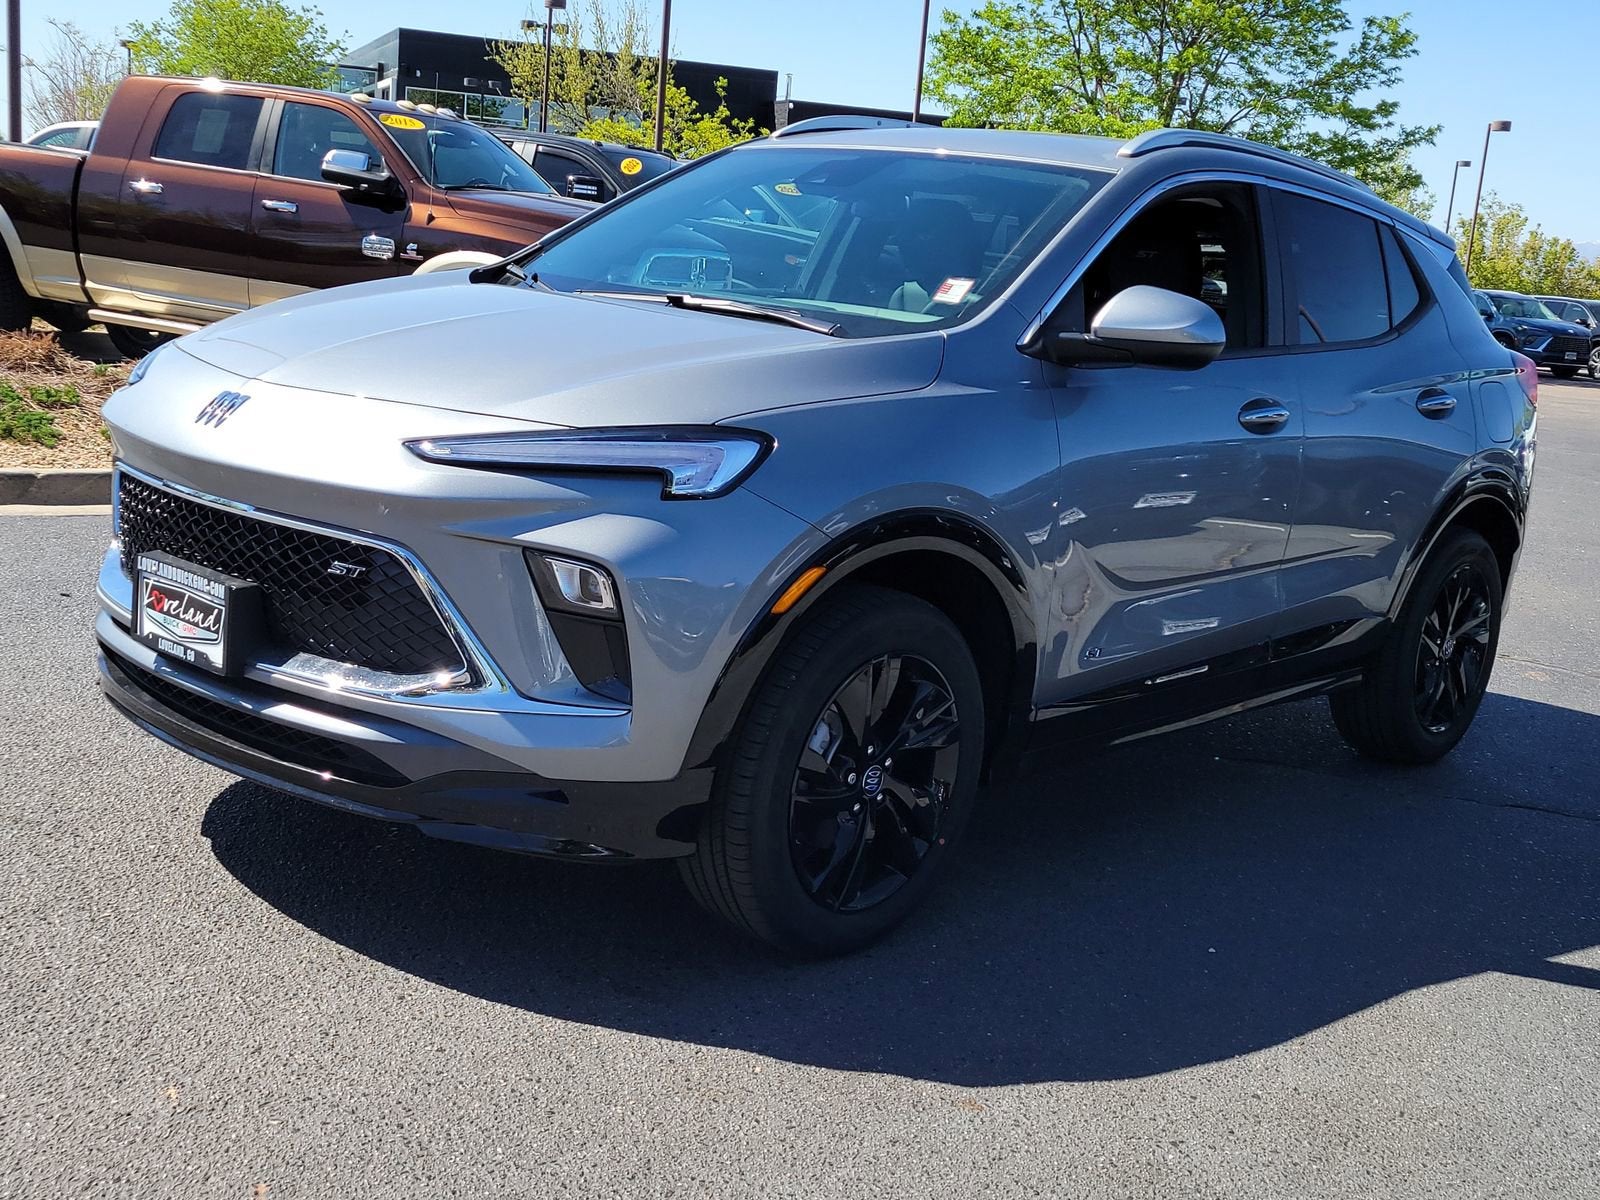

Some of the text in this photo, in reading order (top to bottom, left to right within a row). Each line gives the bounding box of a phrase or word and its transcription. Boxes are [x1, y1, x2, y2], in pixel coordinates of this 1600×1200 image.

[389, 116, 416, 127] 2015
[327, 560, 366, 578] ST
[163, 616, 198, 636] BUICK GMC
